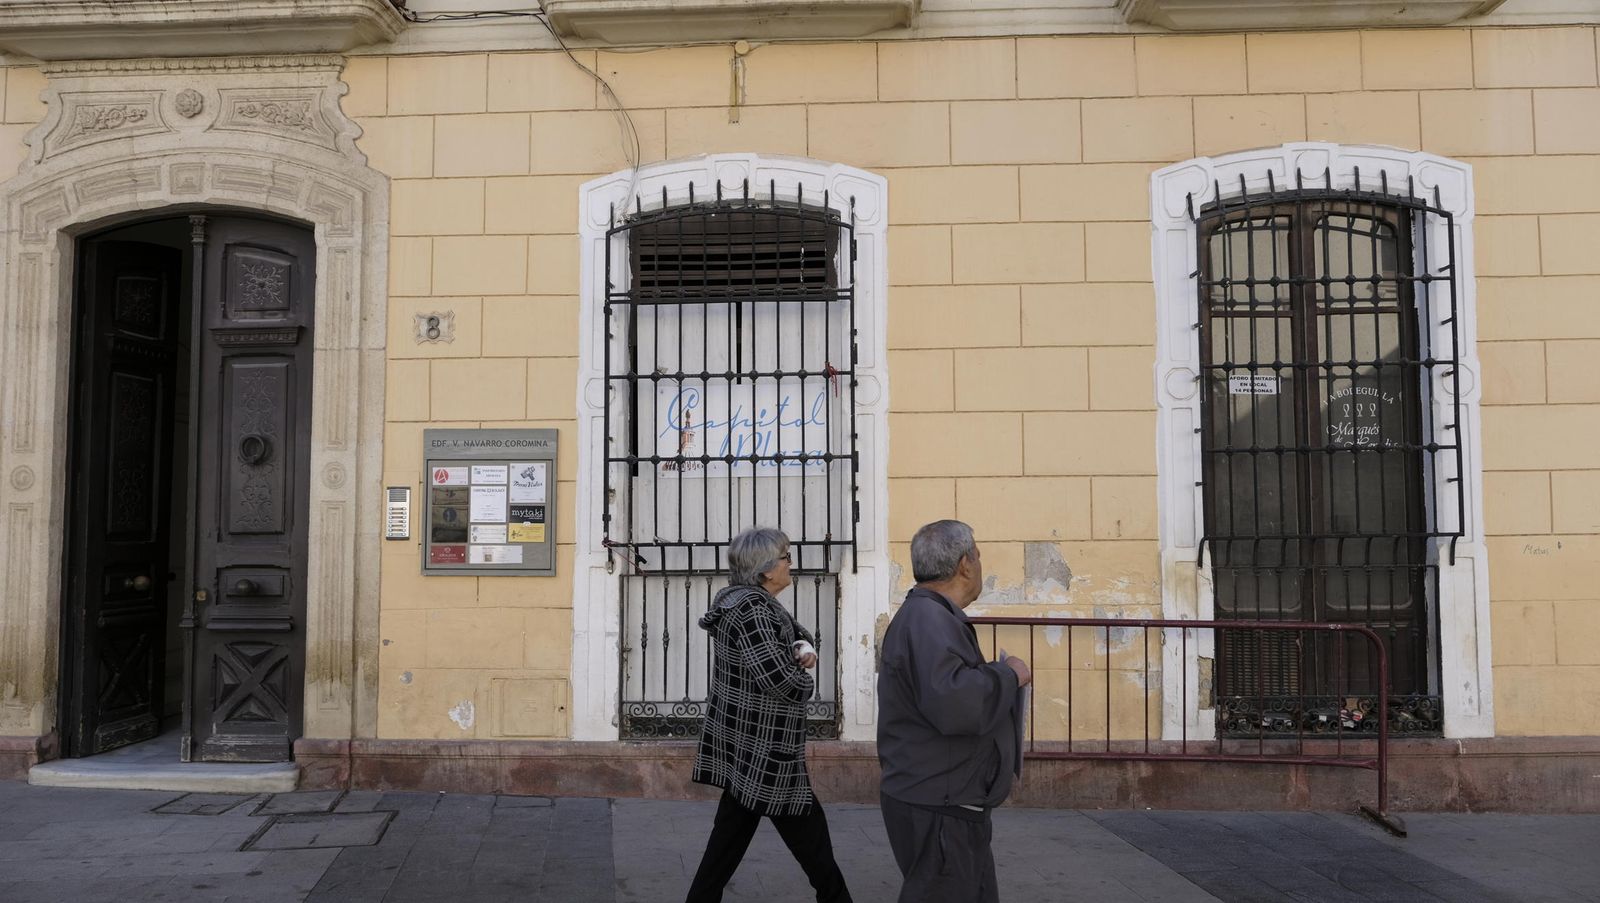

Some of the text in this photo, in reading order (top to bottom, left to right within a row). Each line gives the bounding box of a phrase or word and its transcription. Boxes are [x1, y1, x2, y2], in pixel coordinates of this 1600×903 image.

[426, 316, 440, 340] 8
[1336, 386, 1394, 405] BOEGUILA
[659, 387, 825, 438] Capitol
[431, 439, 549, 448] EDF. V. NAVARRO COROMINA
[719, 430, 823, 467] Plaza
[511, 508, 544, 518] mytaki
